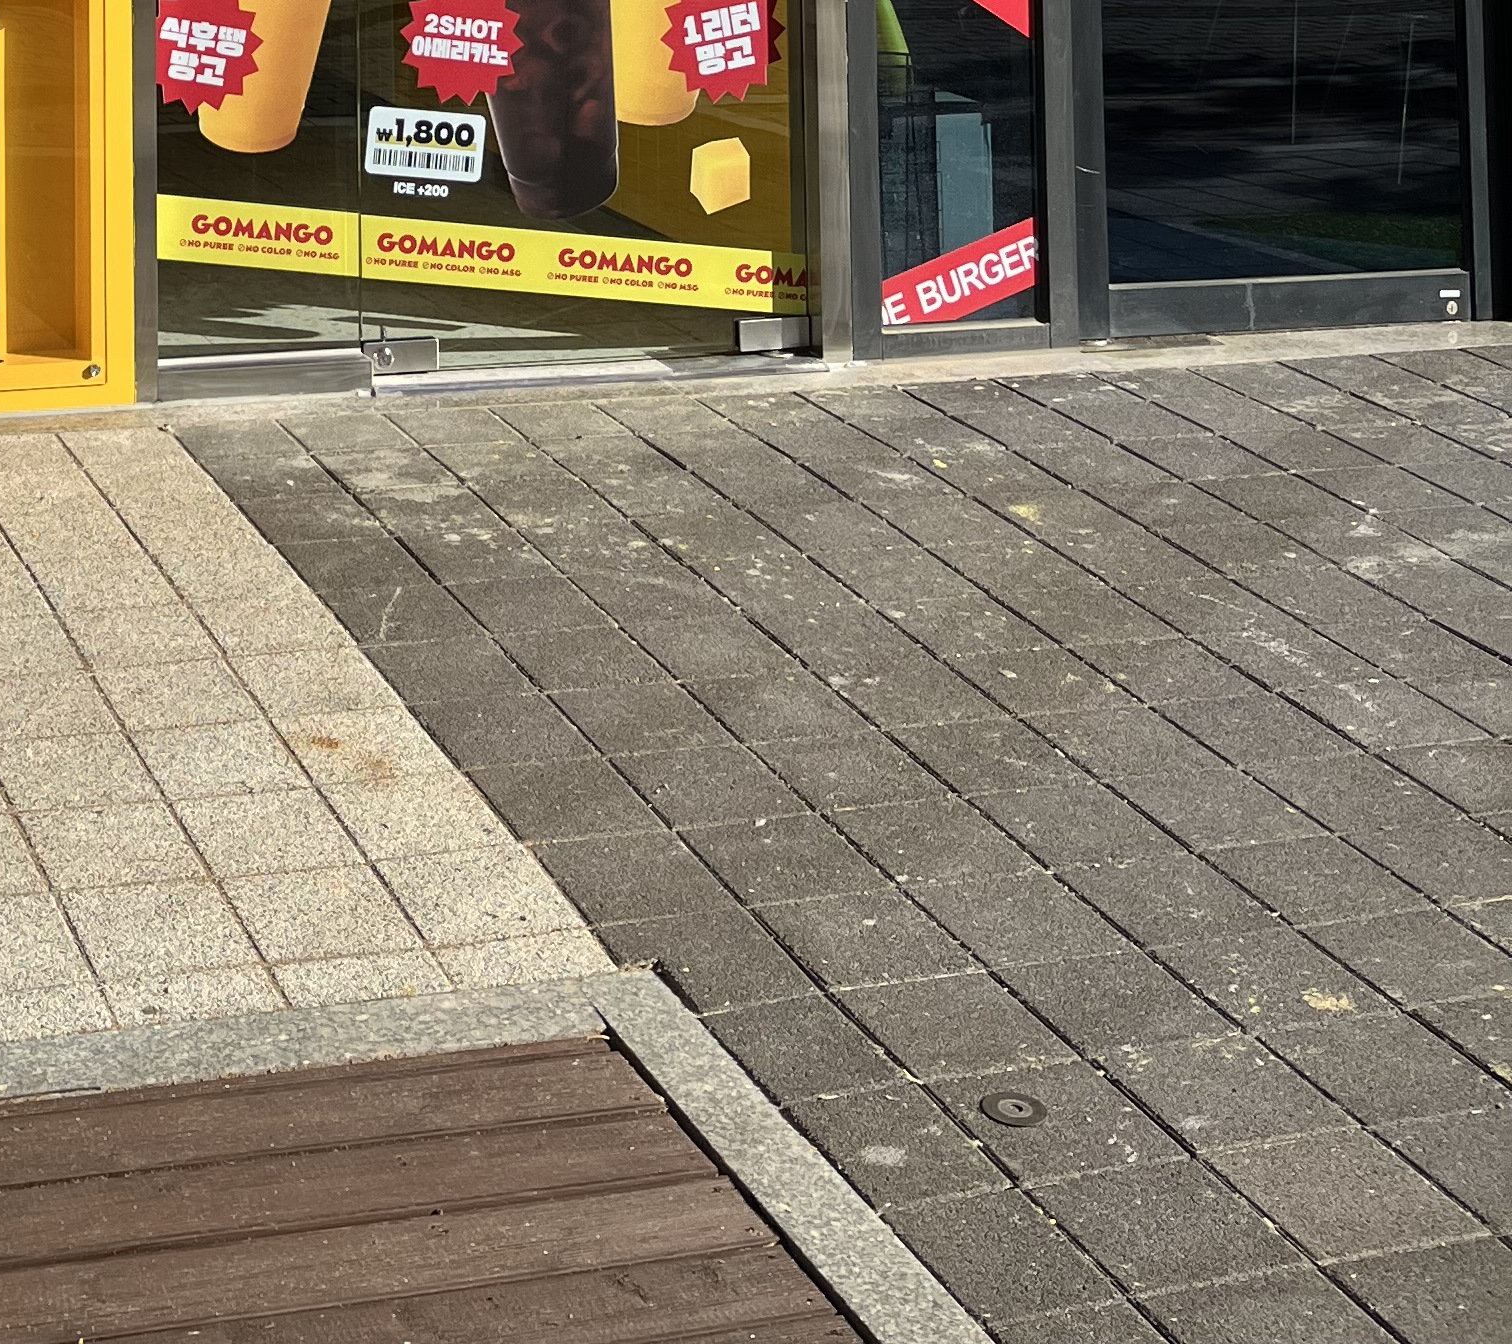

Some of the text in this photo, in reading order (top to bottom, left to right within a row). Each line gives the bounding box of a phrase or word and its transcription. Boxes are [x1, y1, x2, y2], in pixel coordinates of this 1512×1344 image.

[160, 16, 247, 57] 식후땡
[424, 13, 503, 41] 2SHOT
[411, 35, 509, 66] 아메리카노
[695, 35, 756, 76] 망고
[168, 49, 227, 87] 망고
[393, 181, 449, 198] ICE +200
[191, 214, 333, 245] GOMANGO
[187, 239, 340, 261] NO PUREE NO COLOR NO MSG
[377, 232, 515, 262] GOMANGO
[374, 256, 522, 279] NO PUREE NO COLOR NO MSG
[558, 248, 692, 277] GOMANGO
[915, 235, 1040, 315] BURGER
[555, 271, 699, 293] NO PUREE NO COLOR NO MSG
[732, 288, 745, 296] NO
